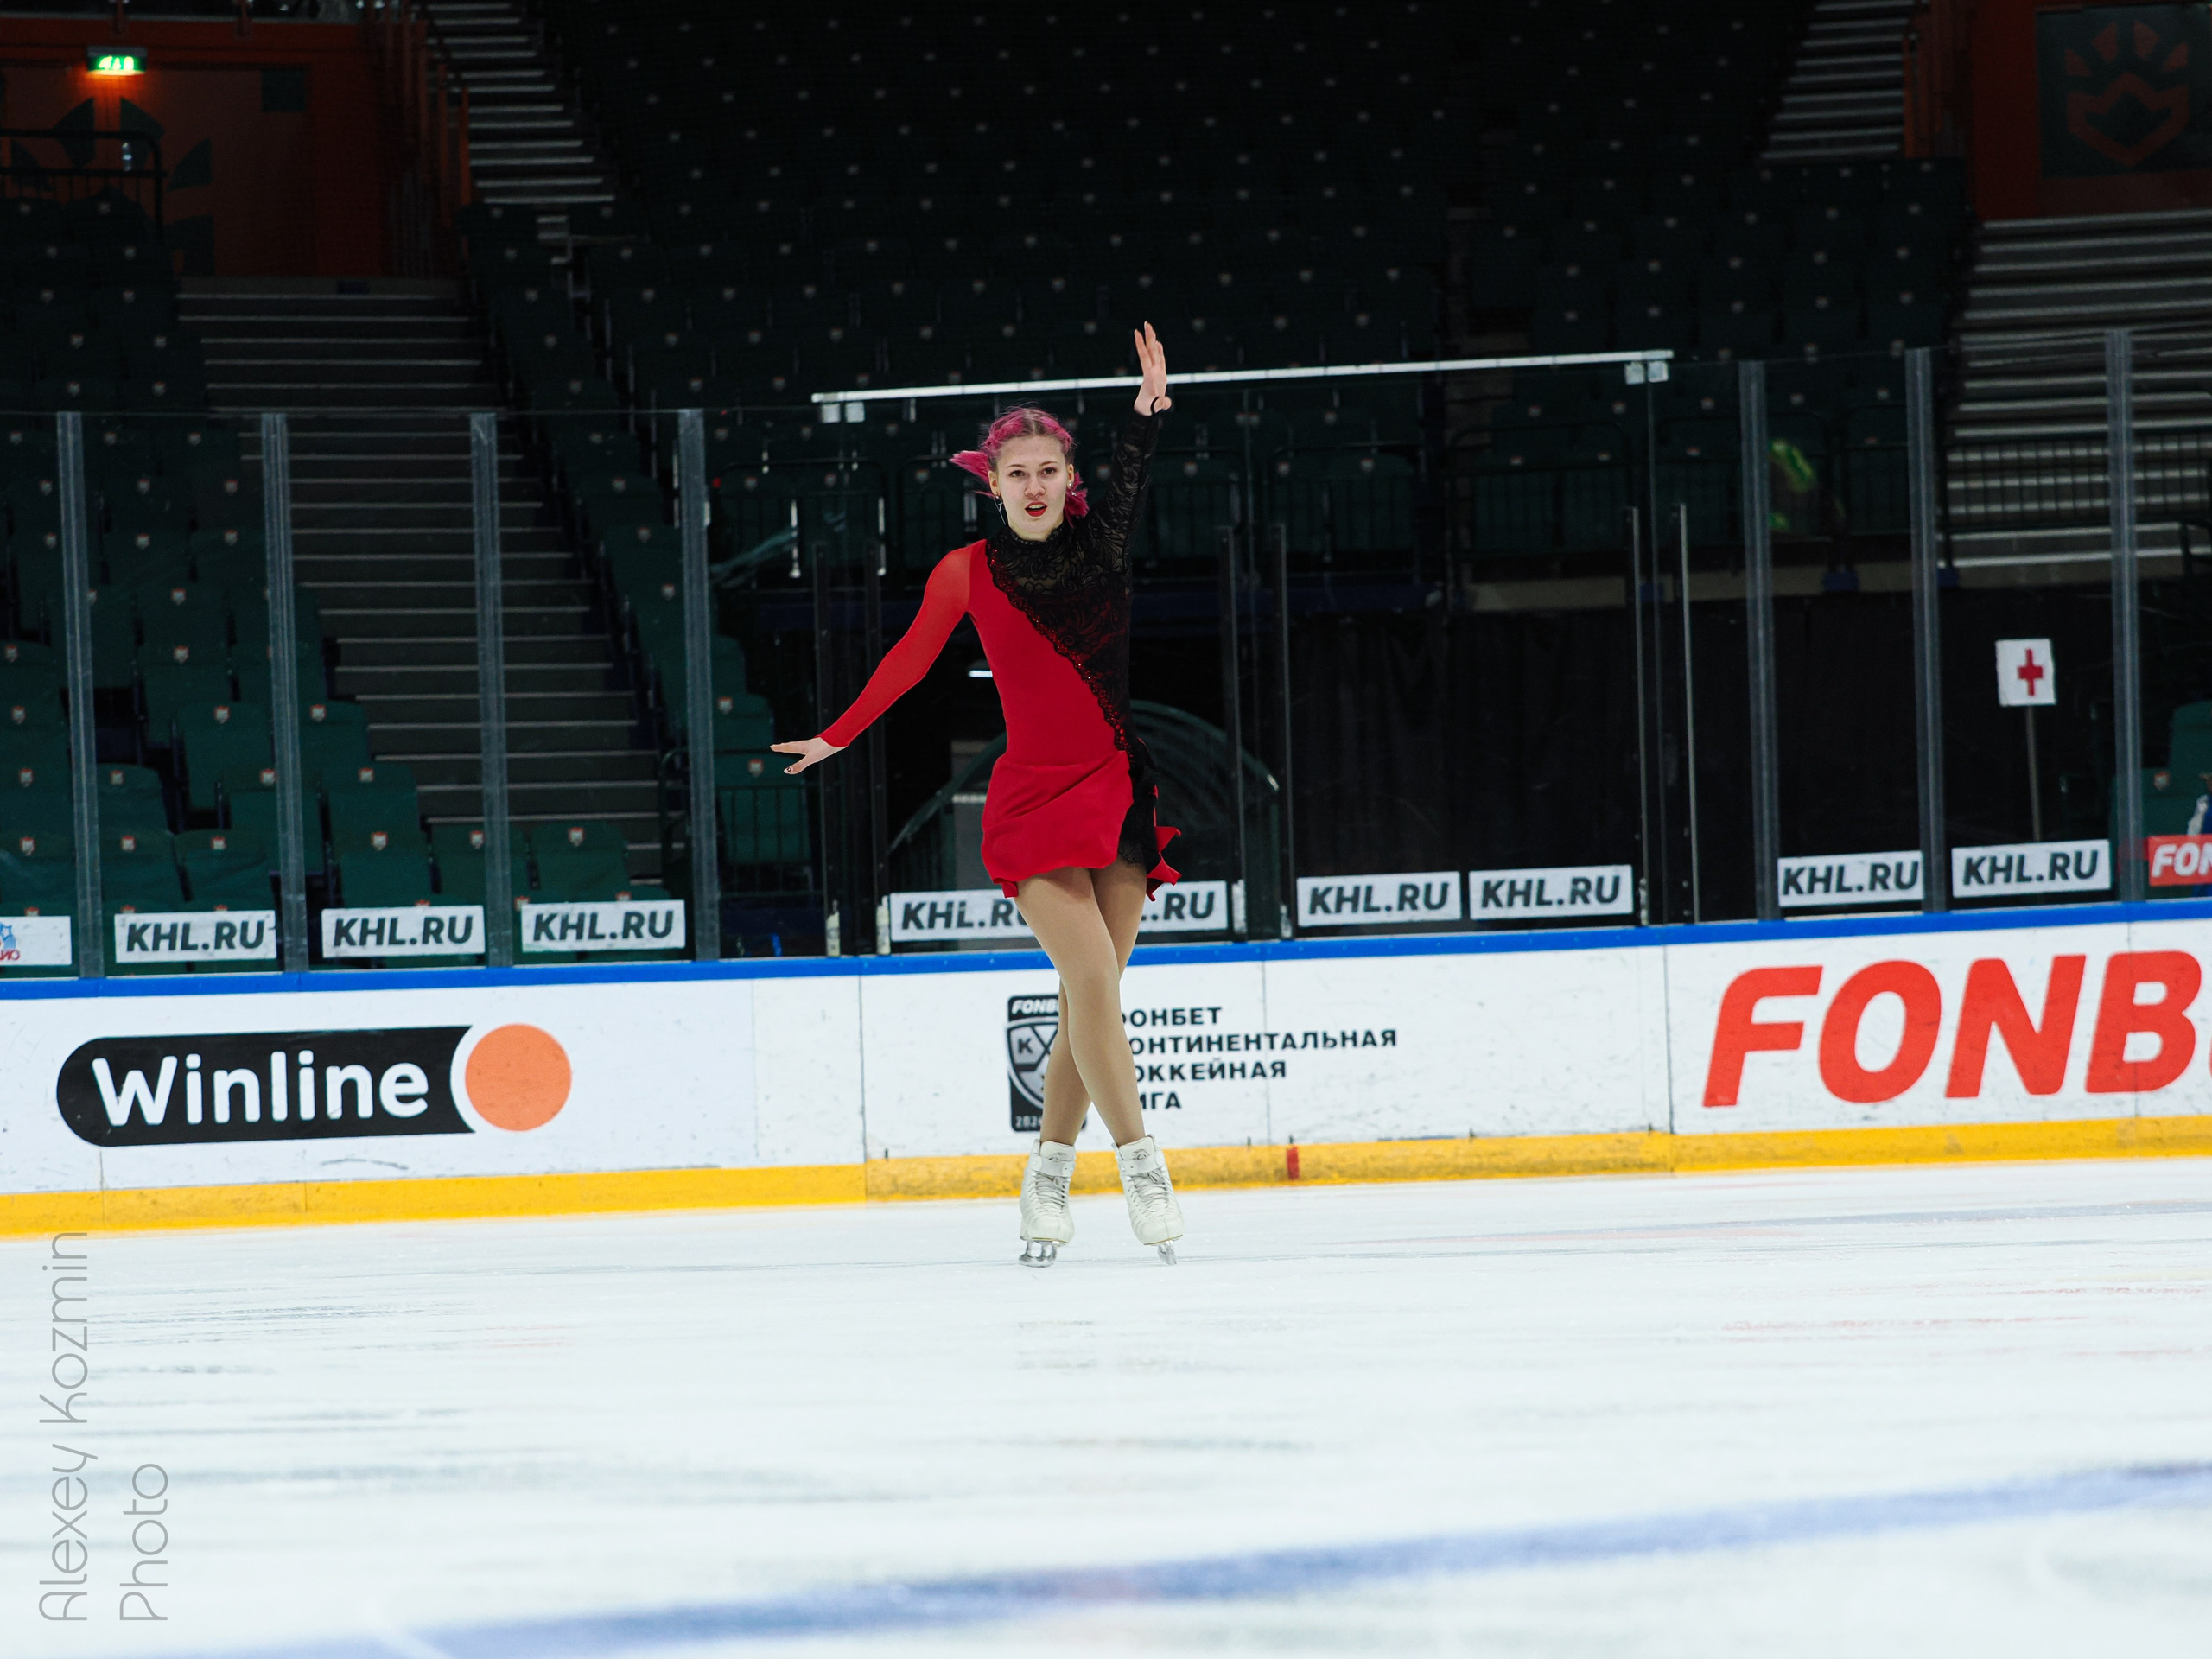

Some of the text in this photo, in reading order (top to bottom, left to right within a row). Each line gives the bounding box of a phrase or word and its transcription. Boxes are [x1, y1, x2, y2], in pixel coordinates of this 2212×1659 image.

[1782, 861, 1919, 896] KHL.RU
[1962, 849, 2099, 887] KHL.RU
[1308, 881, 1450, 915] KHL.RU
[1481, 874, 1620, 909] KHL.RU
[126, 920, 264, 952] KHL.RU
[333, 915, 474, 948] KHL.RU
[533, 910, 674, 942] KHL.RU
[1011, 997, 1058, 1015] FONB
[1122, 1007, 1222, 1027] ОНБЕТ
[1129, 1029, 1397, 1055] ОНТИНЕНТАЛЬНАЯ
[1703, 950, 2212, 1107] FONB
[1135, 1057, 1287, 1083] ОККЕЙНАЯ
[92, 1050, 429, 1128] Winline
